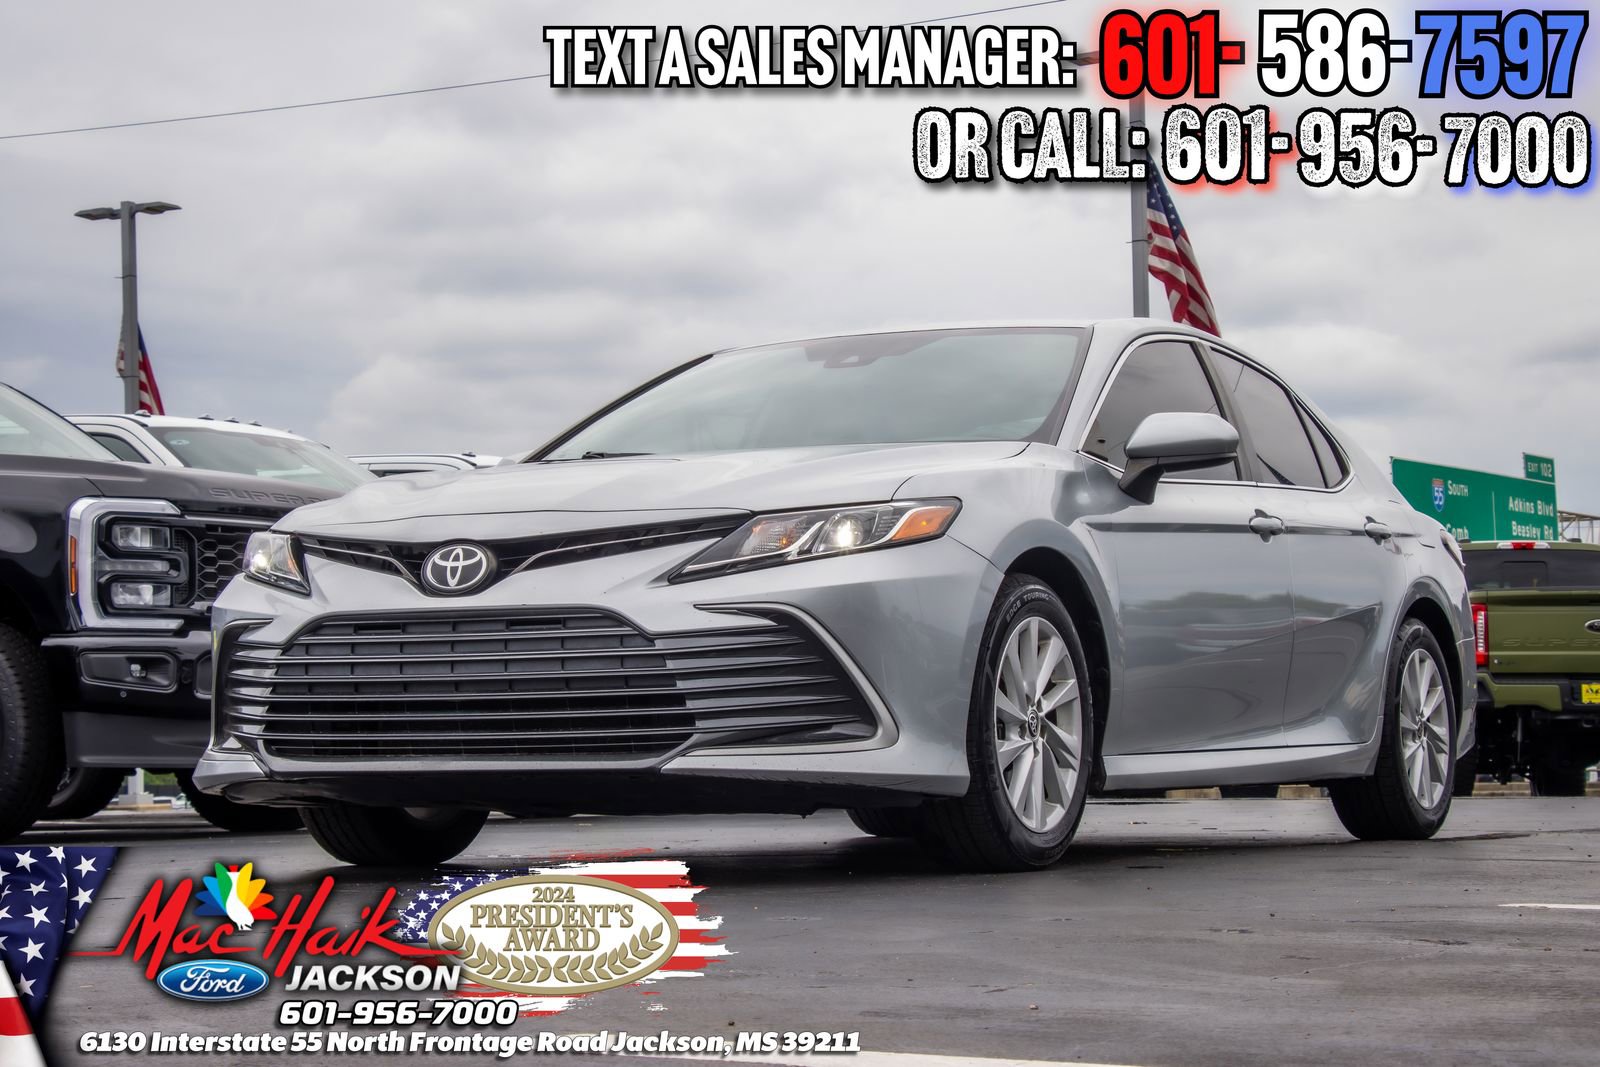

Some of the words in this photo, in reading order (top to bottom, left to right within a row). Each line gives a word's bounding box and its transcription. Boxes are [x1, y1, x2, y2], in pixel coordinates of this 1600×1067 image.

[1527, 462, 1538, 473] EXIT
[1540, 463, 1553, 478] 102
[1433, 487, 1444, 505] 55
[1508, 496, 1535, 514] Adkins
[1537, 500, 1554, 517] Blvd
[1511, 520, 1541, 540] Beasley
[1543, 525, 1554, 540] Rd
